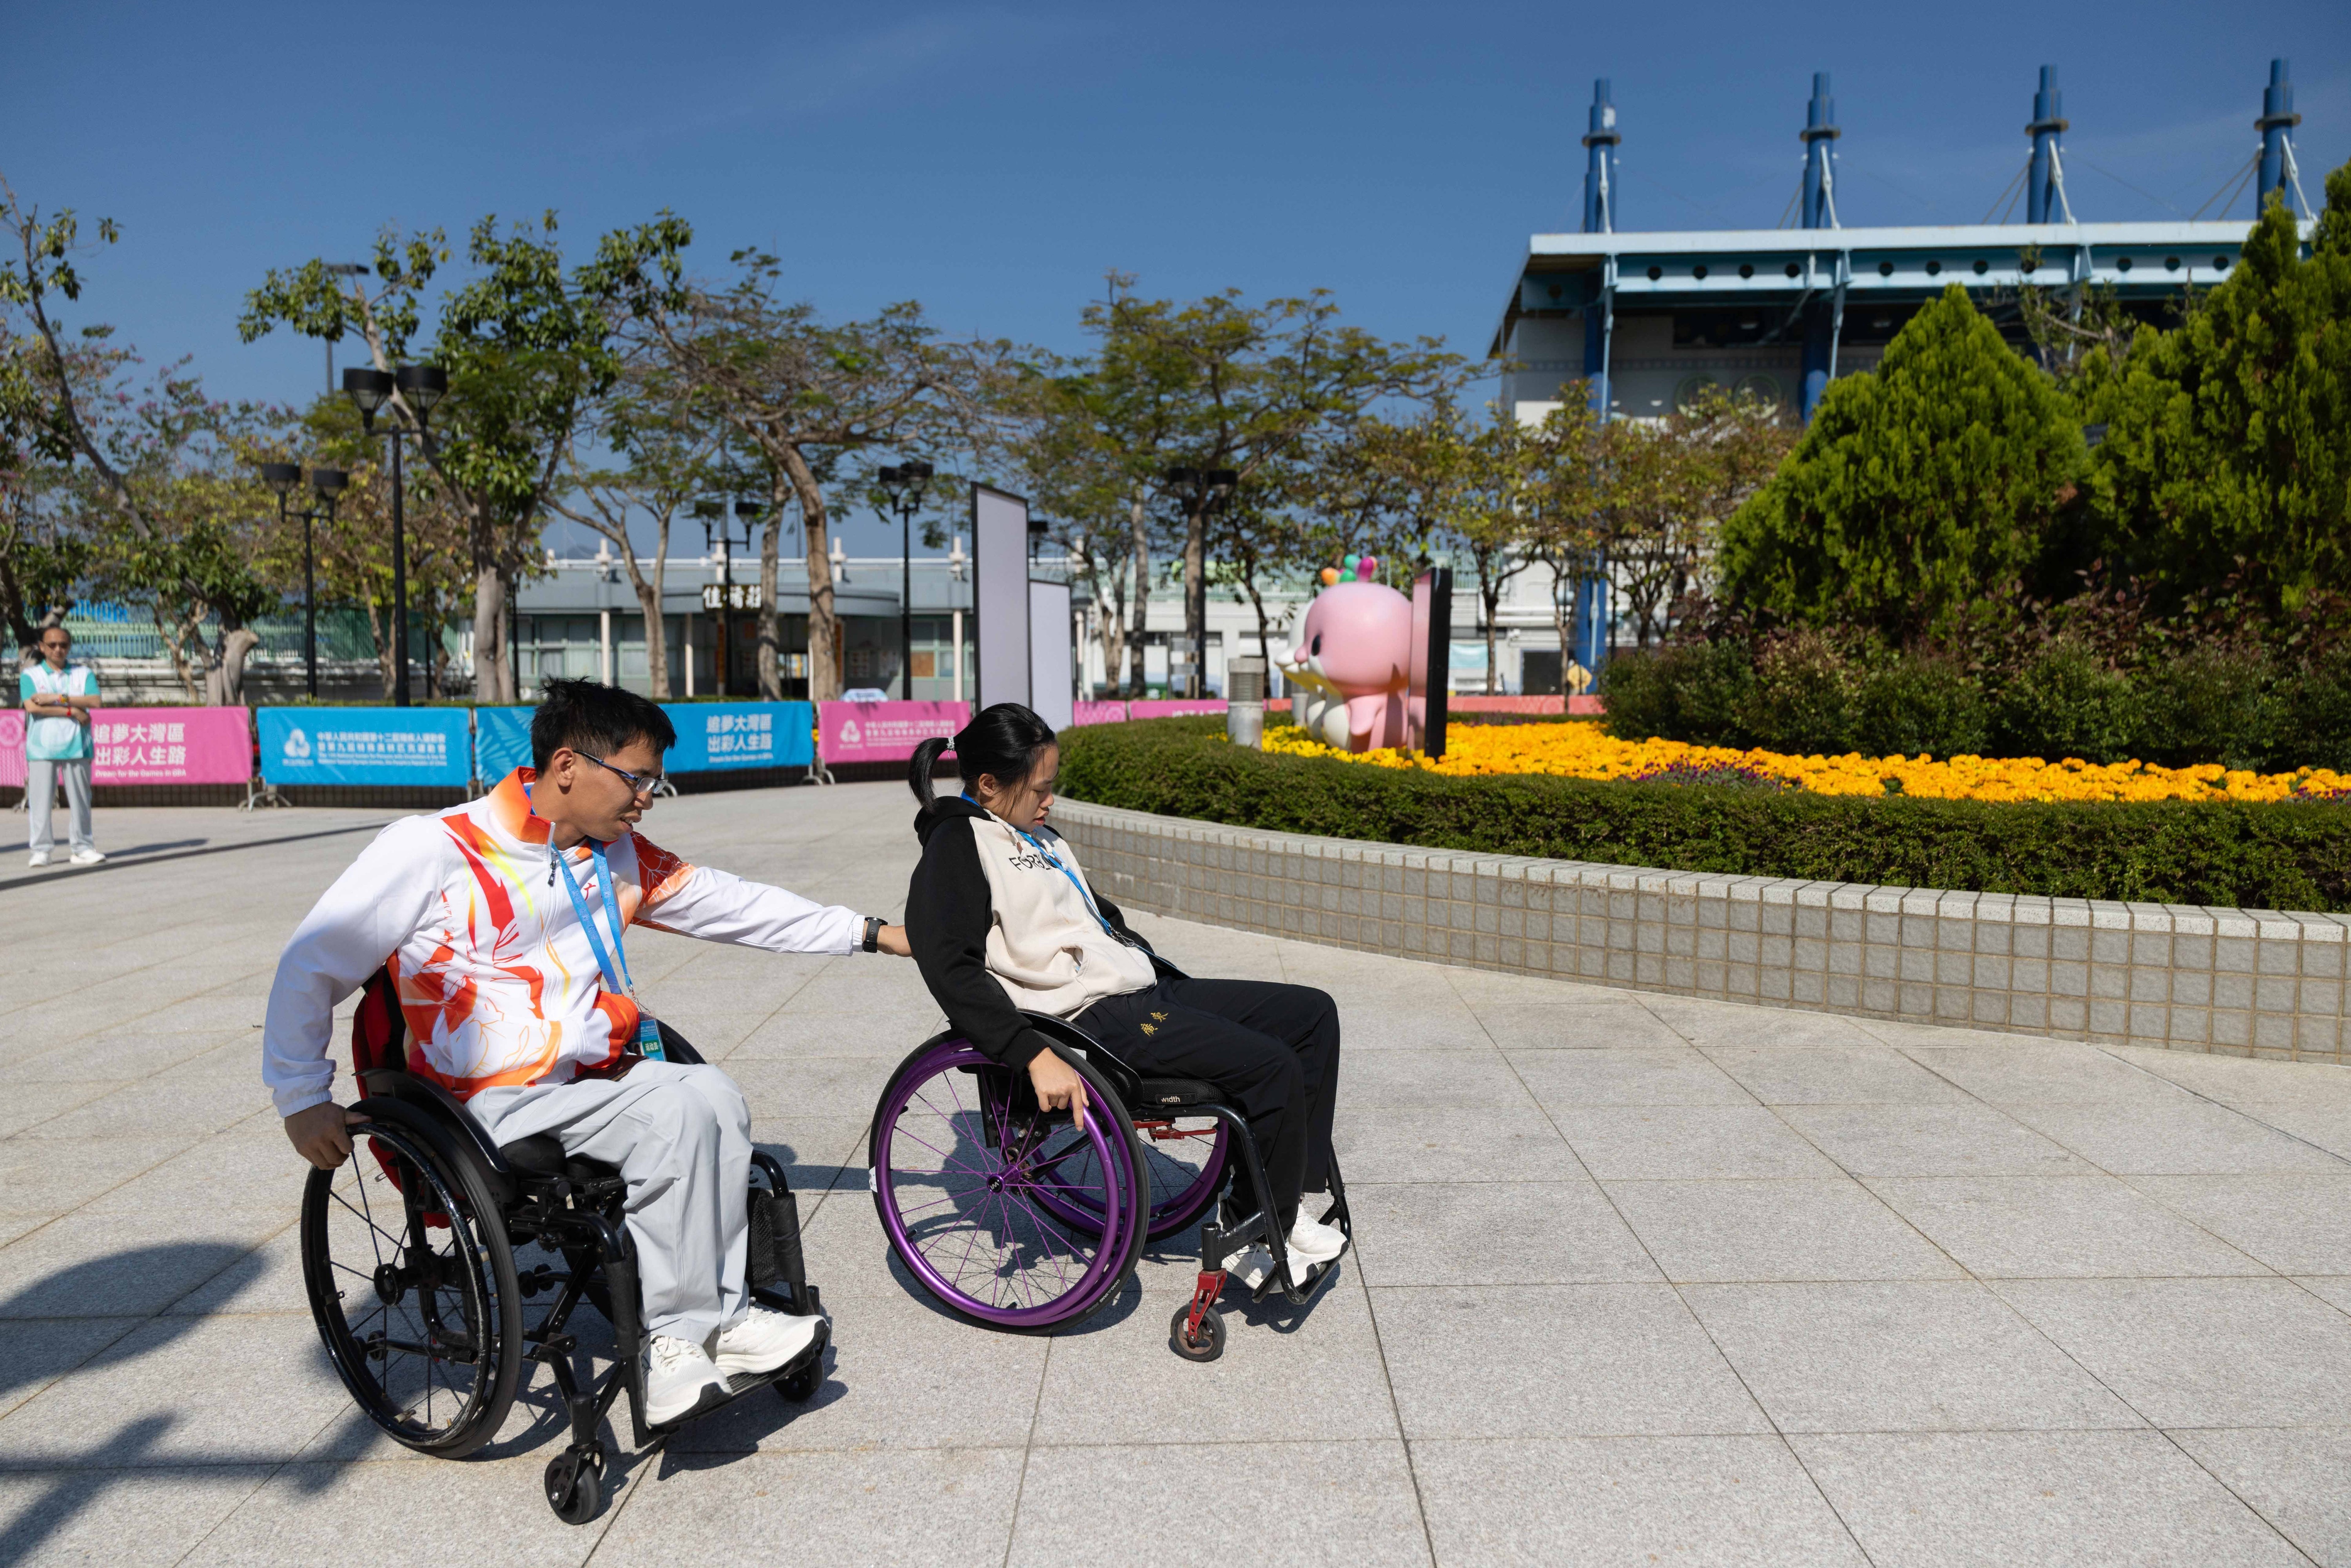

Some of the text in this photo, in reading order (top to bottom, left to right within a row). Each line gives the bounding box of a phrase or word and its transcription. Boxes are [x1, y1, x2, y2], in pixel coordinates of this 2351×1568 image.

[94, 723, 185, 744] 追夢大灣區
[95, 745, 186, 766] 出彩人生路
[645, 1042, 659, 1051] 运动员
